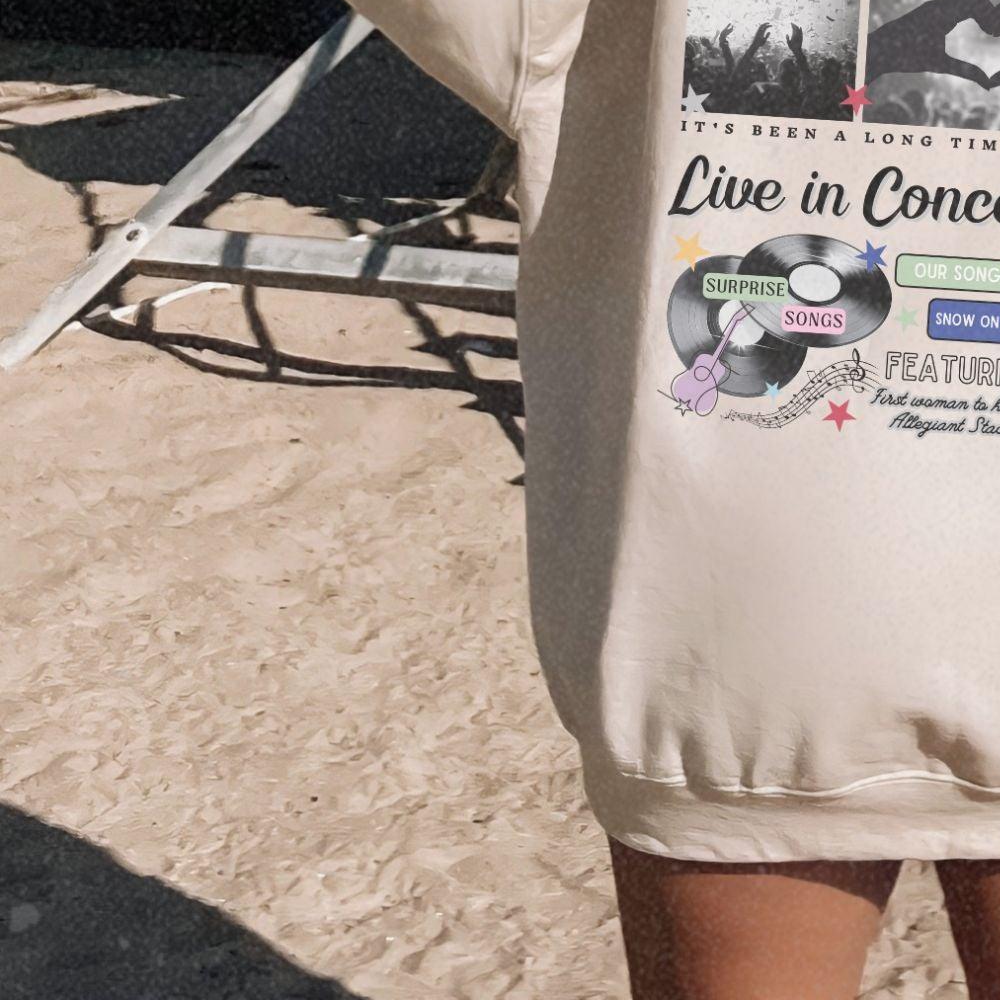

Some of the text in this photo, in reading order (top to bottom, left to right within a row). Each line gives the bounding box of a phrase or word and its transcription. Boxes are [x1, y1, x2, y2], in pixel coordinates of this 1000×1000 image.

[680, 120, 735, 135] IT'S
[752, 124, 818, 140] BEEN
[834, 130, 847, 142] A
[865, 132, 933, 148] LONG
[668, 154, 786, 216] Live
[800, 171, 850, 217] in
[914, 263, 1000, 283] OUR SONG
[705, 277, 786, 298] SURPRISE
[785, 310, 843, 329] SONGS
[935, 312, 975, 328] SNOW
[980, 314, 1000, 329] ON
[870, 388, 908, 406] First
[910, 396, 969, 411] woman
[973, 397, 989, 412] to
[889, 411, 965, 438] Allegiant
